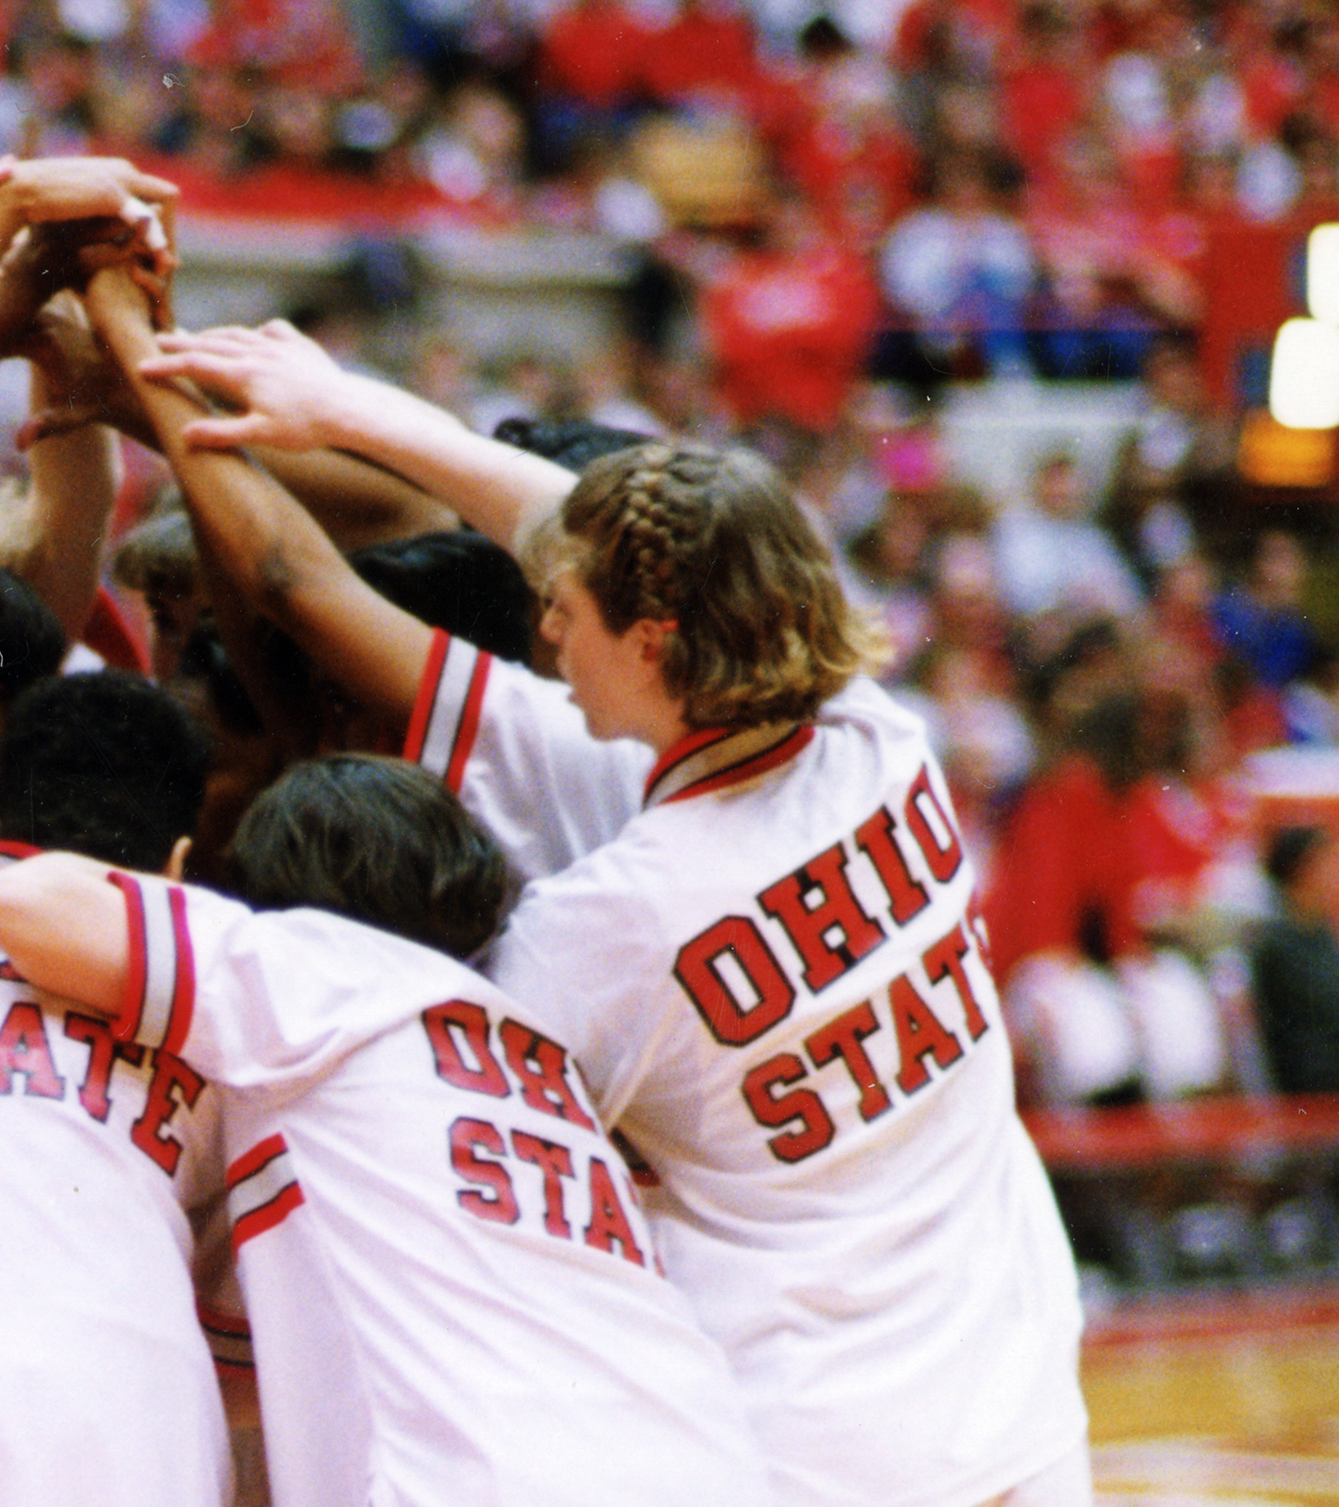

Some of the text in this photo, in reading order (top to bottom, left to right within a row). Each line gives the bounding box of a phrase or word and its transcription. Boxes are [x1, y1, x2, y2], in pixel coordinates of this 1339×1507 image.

[672, 762, 963, 1048] OHIO
[421, 998, 597, 1133] OH
[741, 918, 989, 1164] STAT
[448, 1116, 657, 1275] STA
